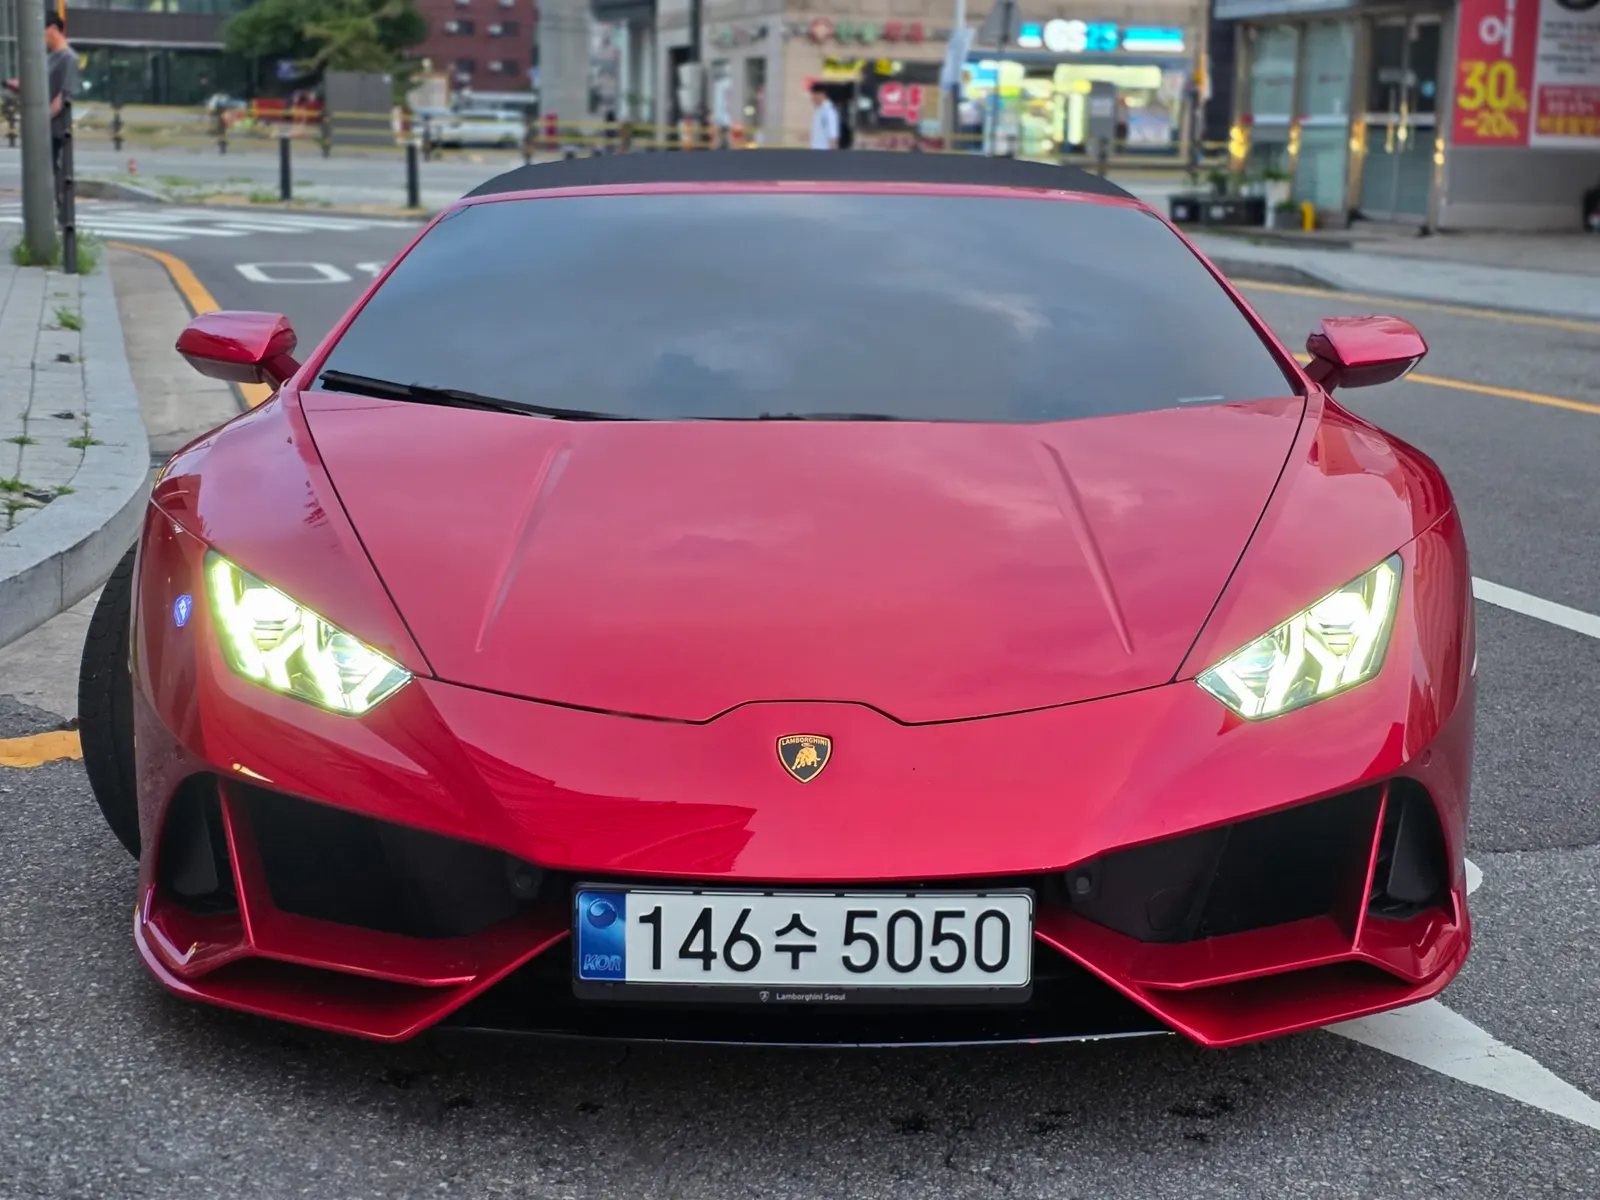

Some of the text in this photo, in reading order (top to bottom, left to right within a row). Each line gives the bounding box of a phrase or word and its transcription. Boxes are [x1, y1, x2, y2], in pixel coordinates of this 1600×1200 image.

[782, 737, 828, 746] LAMBORGHINI
[638, 906, 1011, 974] 146수 5050
[583, 954, 622, 971] KOR
[776, 993, 846, 1002] Lamborghini Seoul
